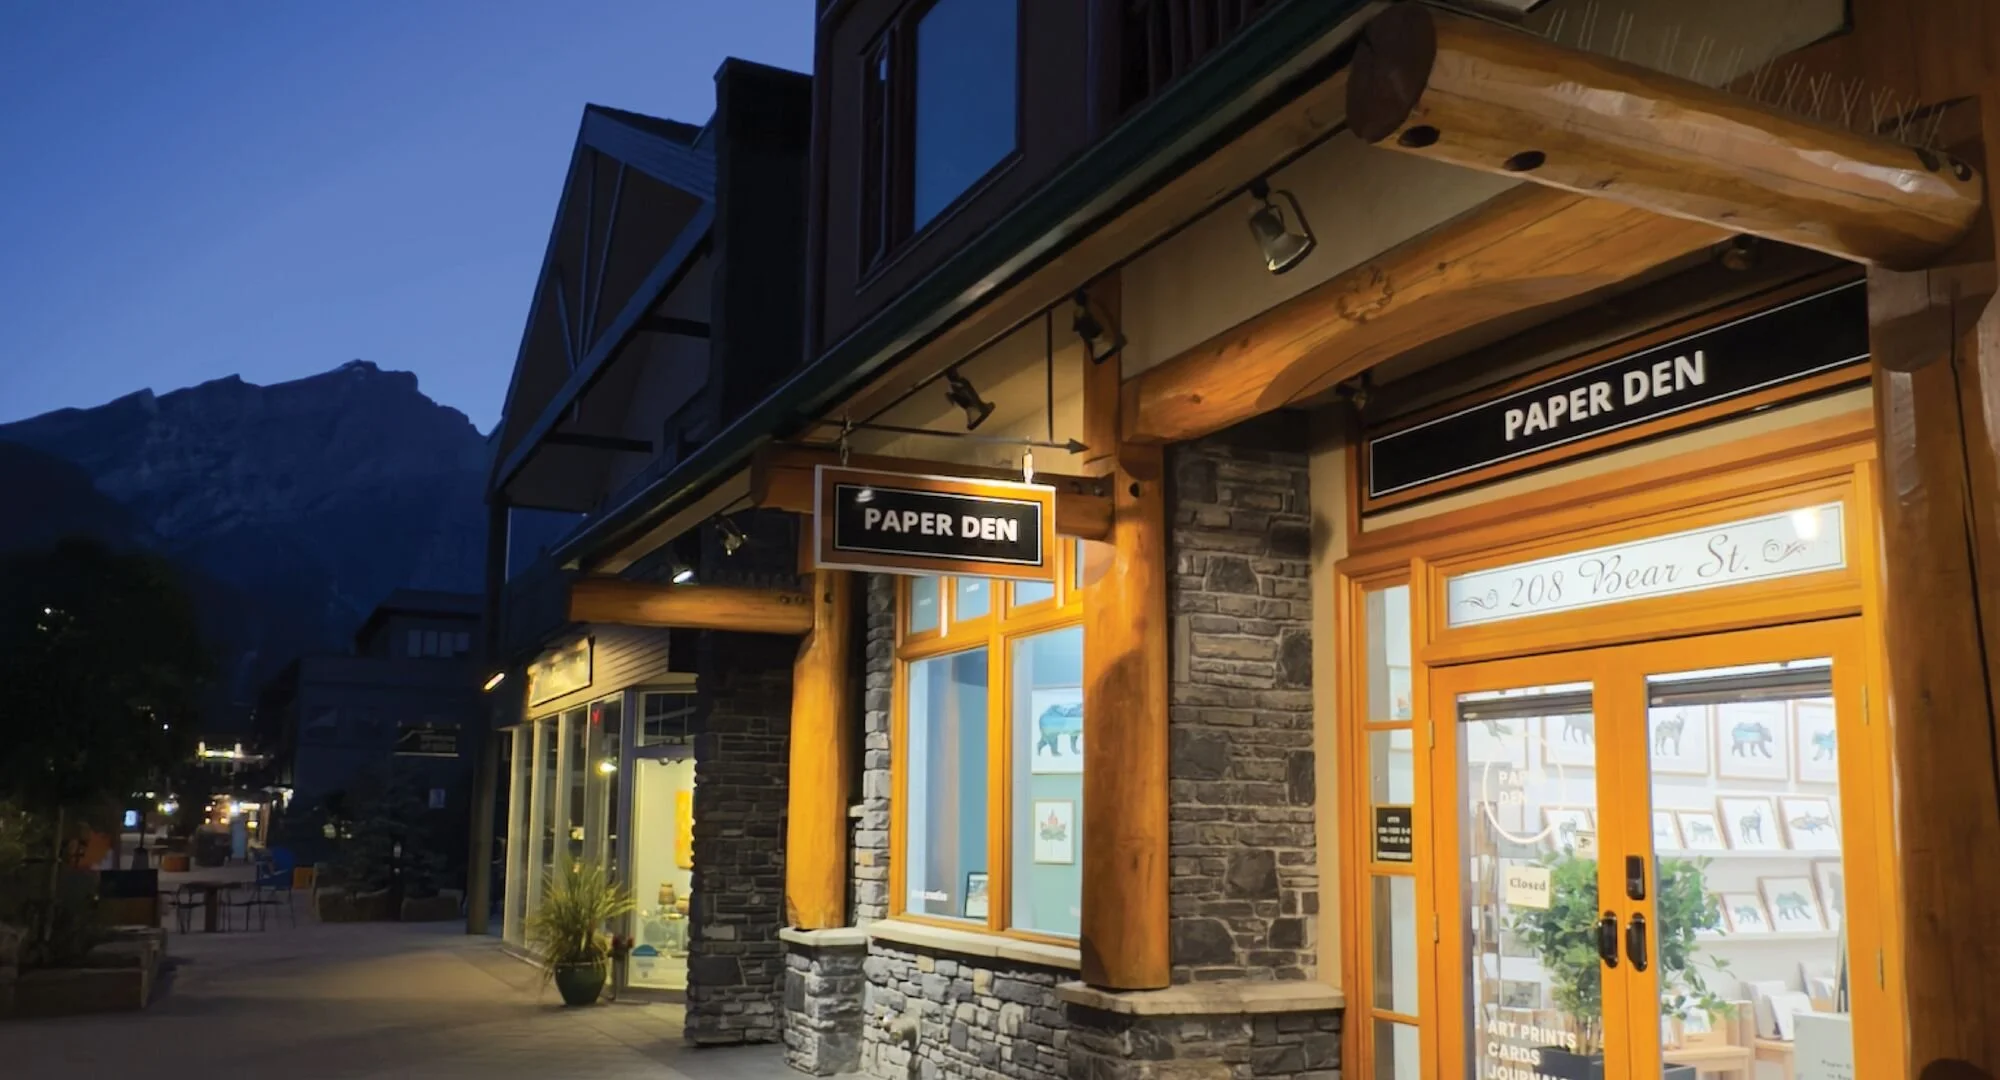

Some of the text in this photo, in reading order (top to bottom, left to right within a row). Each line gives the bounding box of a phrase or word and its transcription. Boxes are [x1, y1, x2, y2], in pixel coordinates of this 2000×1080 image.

[1505, 350, 1706, 442] PAPER DEN
[864, 507, 1018, 542] PAPER DEN
[1510, 534, 1750, 608] 208 Bear St.
[1509, 878, 1546, 891] Closed
[1487, 1019, 1577, 1049] ART PRINTS
[1487, 1041, 1541, 1067] CARDS
[1488, 1064, 1568, 1080] JOURN
